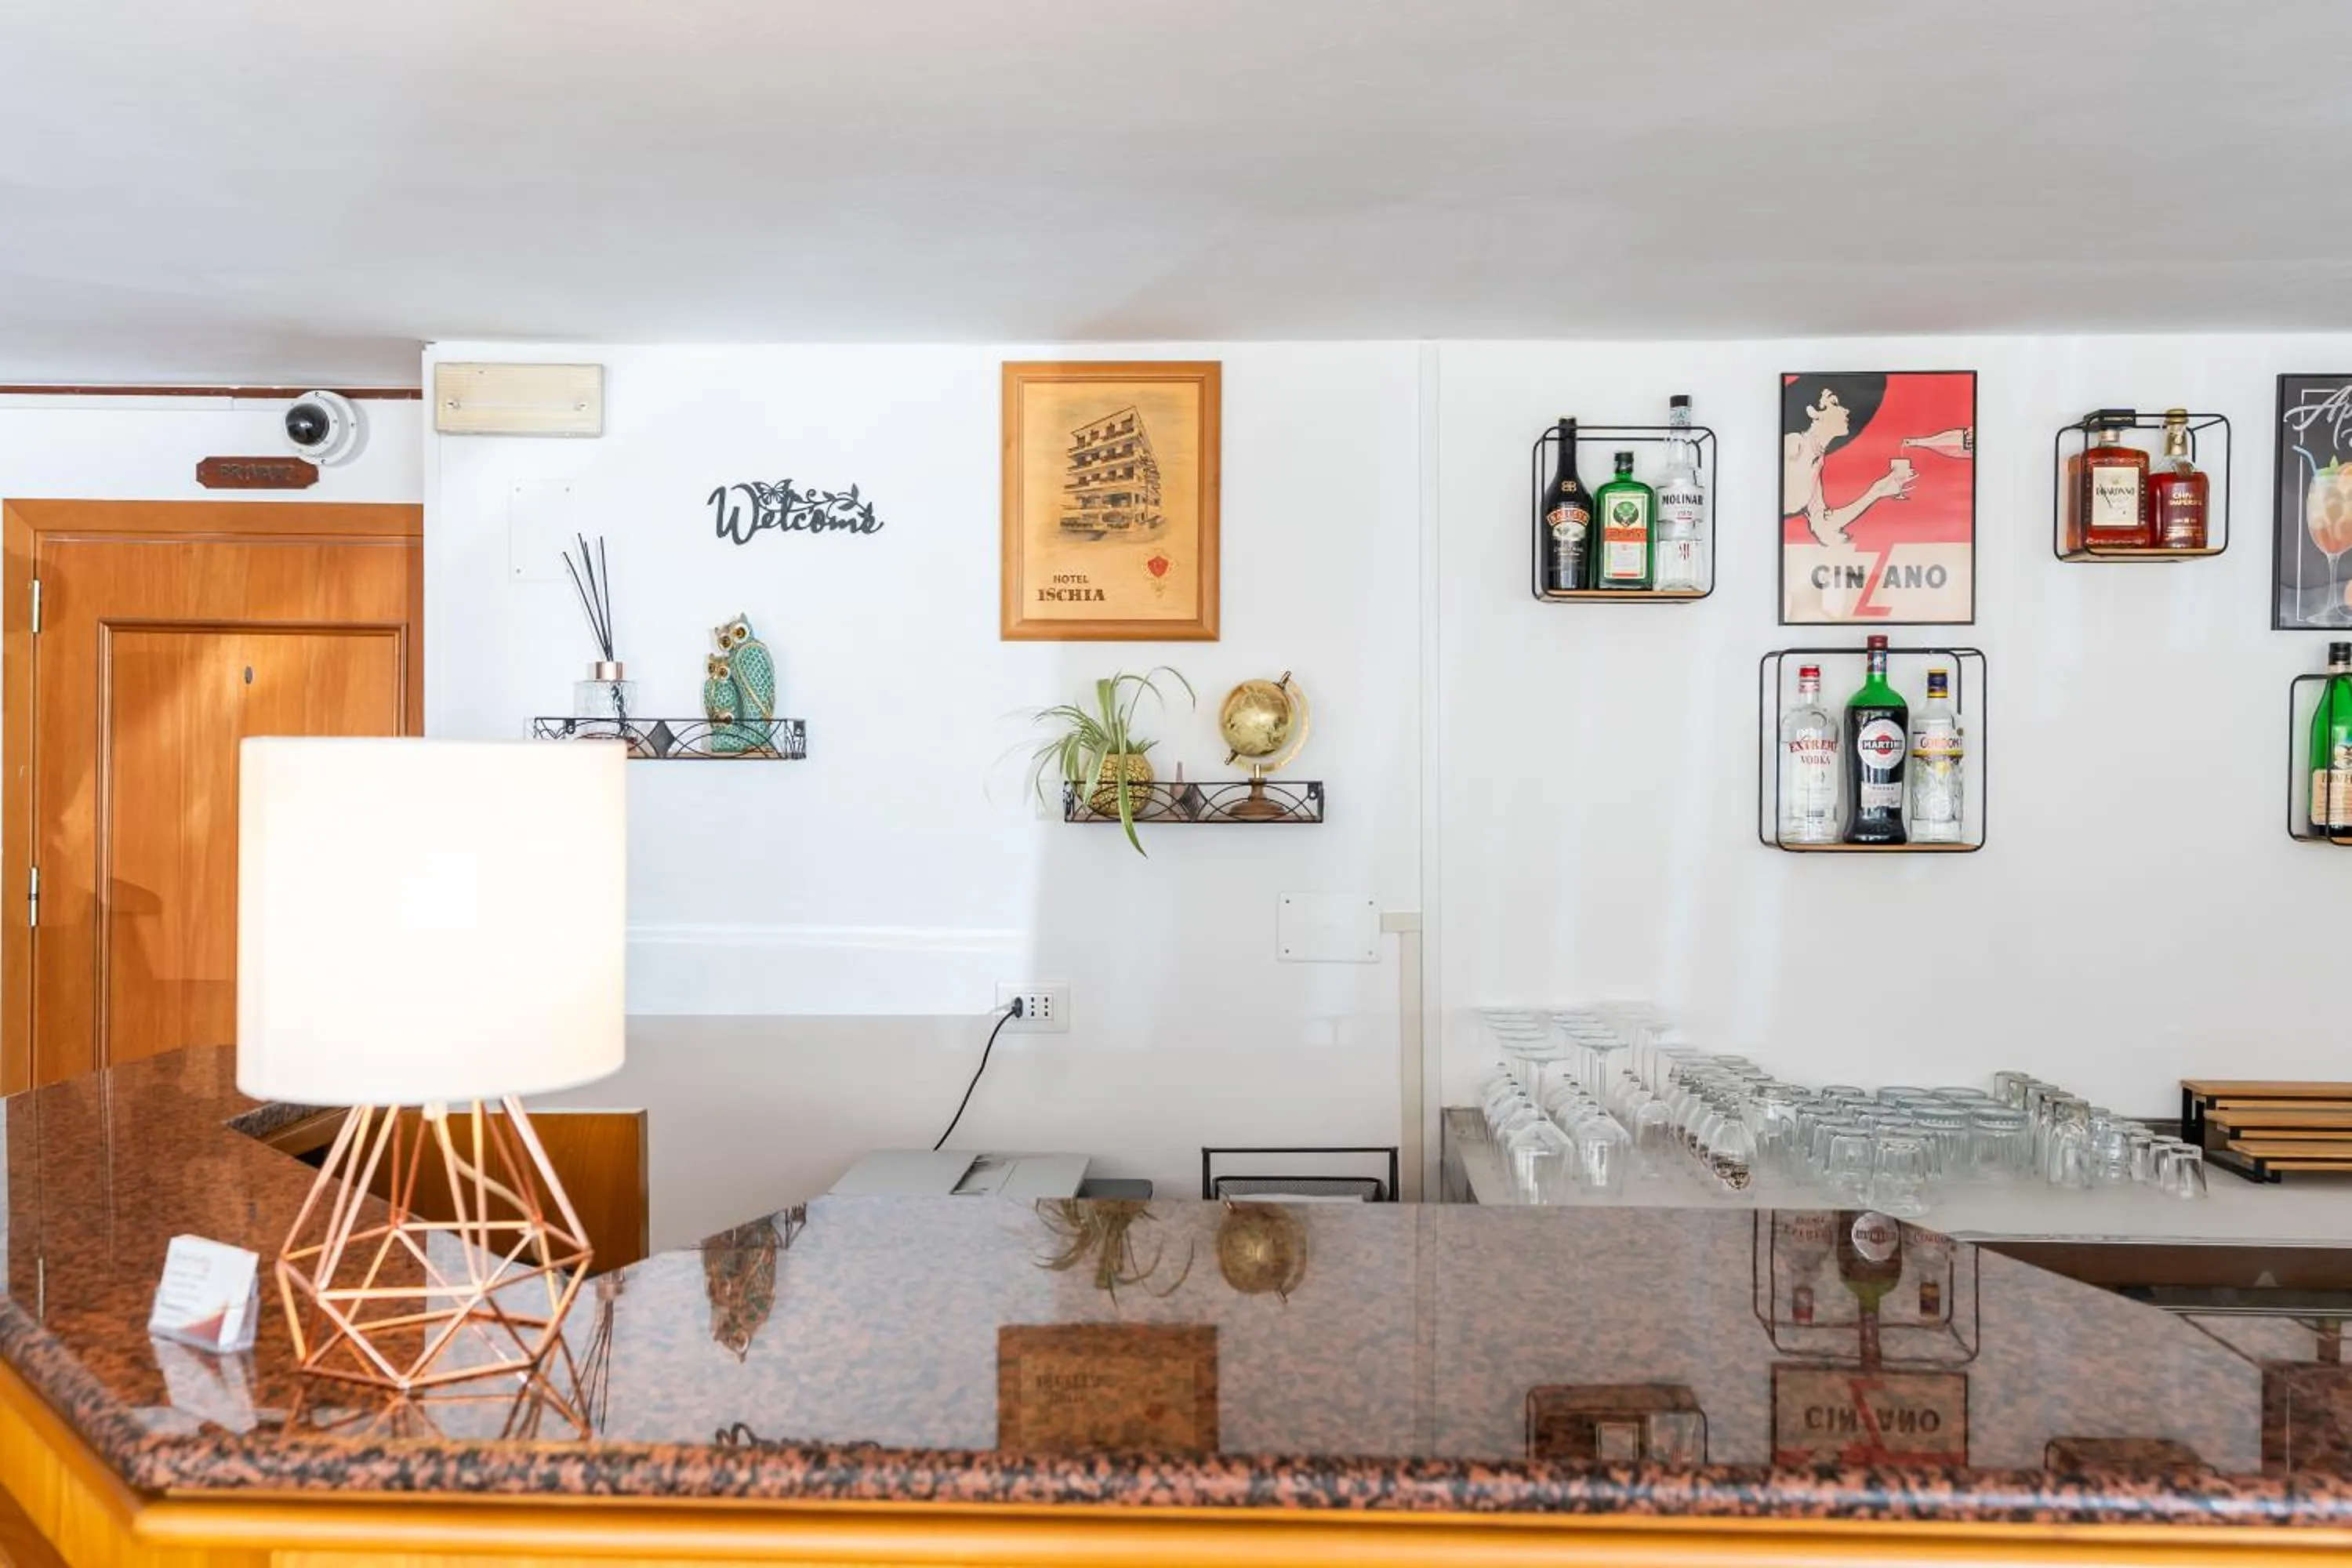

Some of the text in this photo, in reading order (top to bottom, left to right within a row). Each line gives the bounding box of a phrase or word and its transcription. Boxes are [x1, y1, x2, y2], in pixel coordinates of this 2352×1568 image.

[707, 481, 884, 545] Welcome
[1053, 574, 1089, 584] HOTEL
[1811, 543, 1947, 617] CINZANO
[1036, 587, 1105, 601] ISCHIA
[1863, 740, 1903, 750] MARTI
